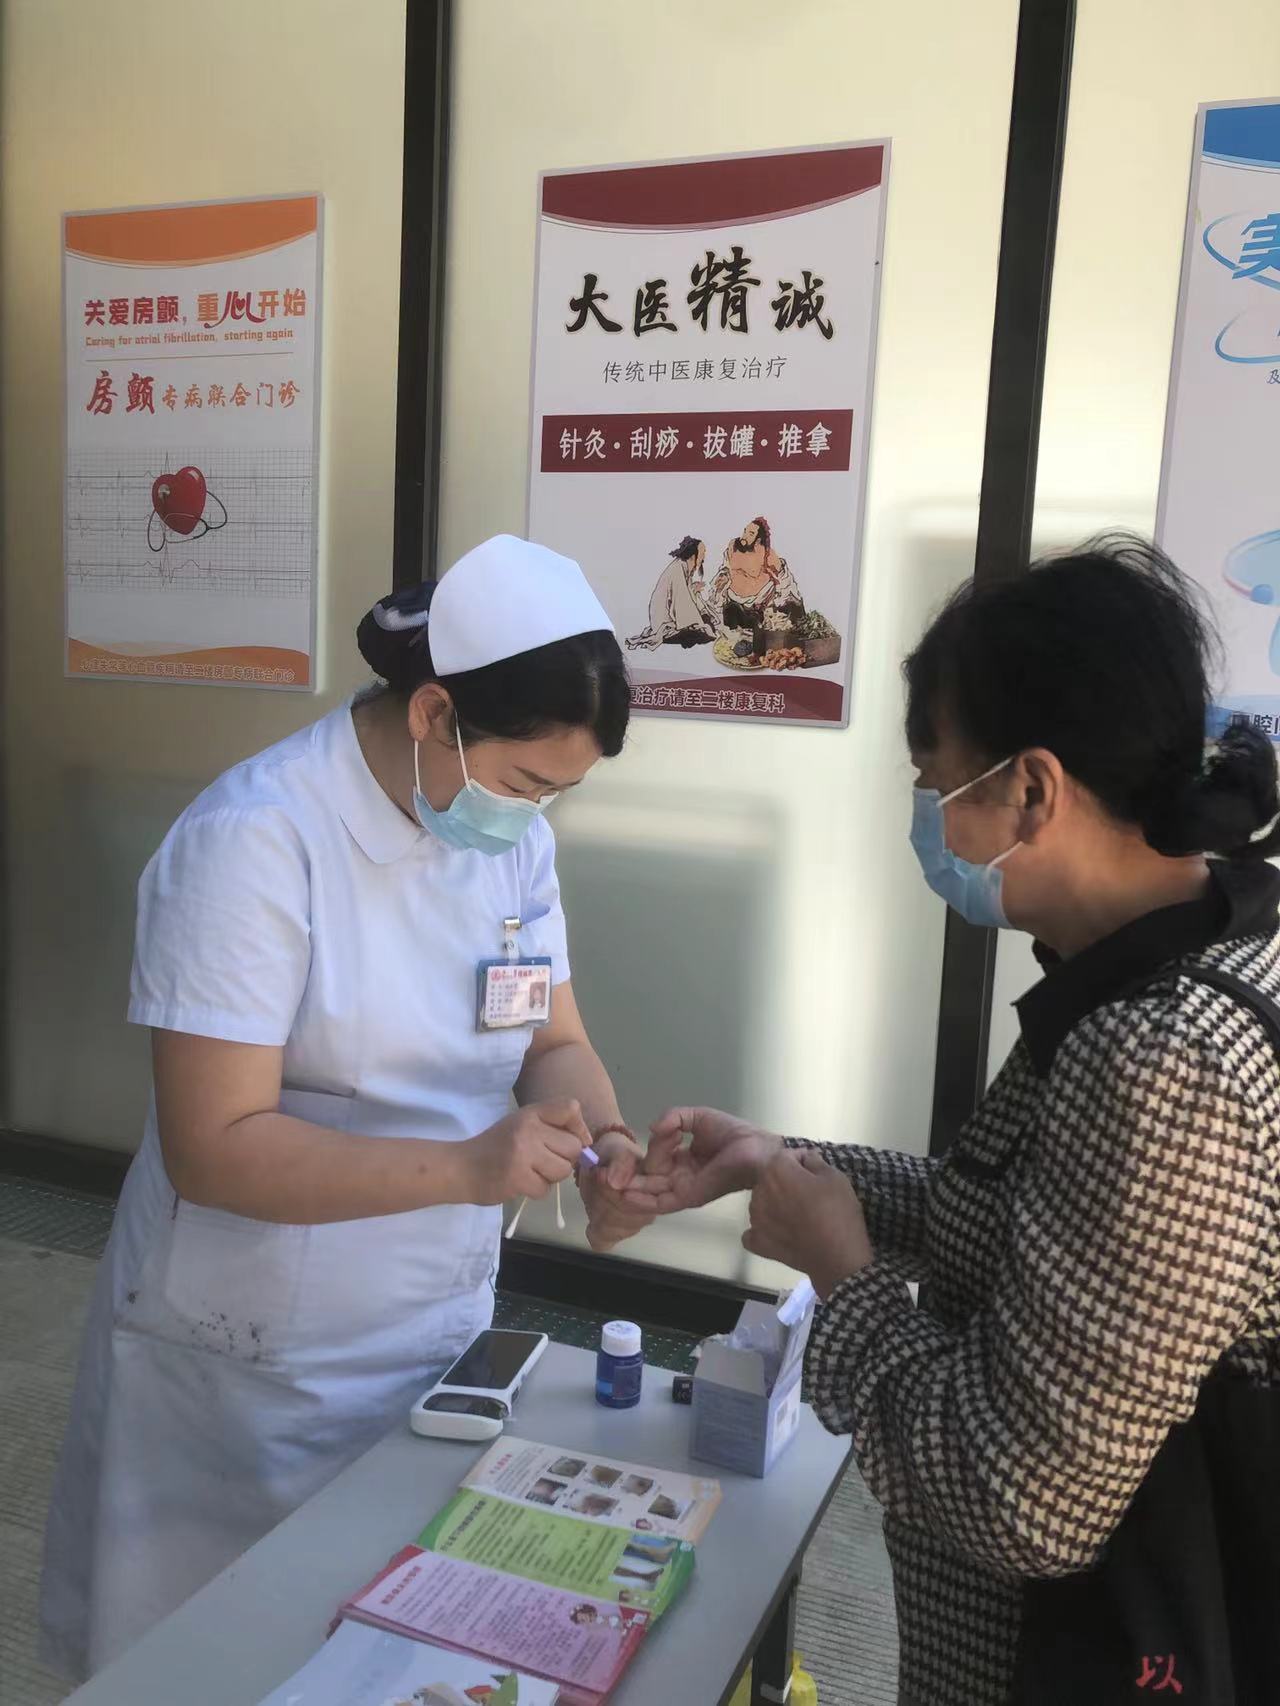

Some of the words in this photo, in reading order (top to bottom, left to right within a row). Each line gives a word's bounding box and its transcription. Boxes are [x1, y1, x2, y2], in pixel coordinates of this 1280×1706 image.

[565, 246, 834, 340] 大医精诚
[85, 336, 115, 348] Caring
[118, 335, 132, 345] for
[135, 333, 161, 345] atrial
[224, 330, 263, 341] starting
[266, 328, 293, 340] again
[603, 356, 787, 384] 传统中医康复治疗
[1135, 1653, 1183, 1694] 以
